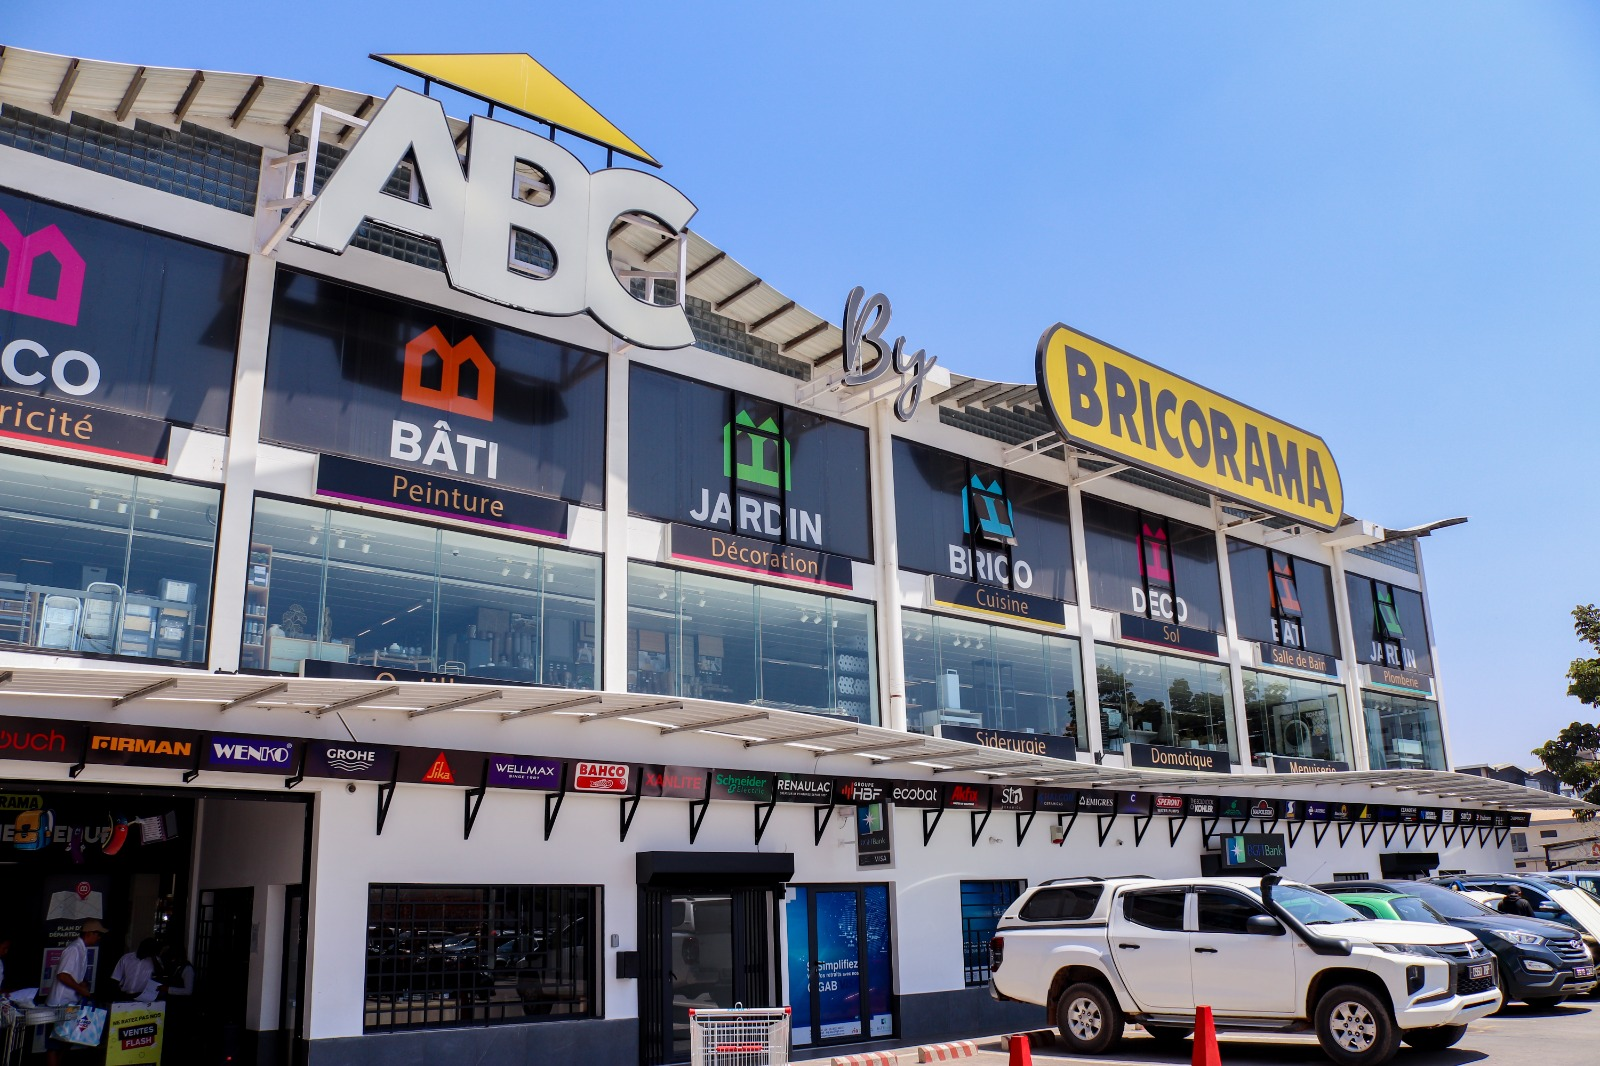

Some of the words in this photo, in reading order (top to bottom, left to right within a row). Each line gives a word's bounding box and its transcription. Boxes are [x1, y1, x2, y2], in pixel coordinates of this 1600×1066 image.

[287, 84, 699, 344] ABC
[841, 285, 938, 421] By
[1064, 344, 1334, 514] BRICORAMA
[389, 419, 499, 480] BÂTI
[392, 475, 505, 517] Peinture
[690, 487, 823, 546] JARDIN
[711, 537, 819, 575] Décoration
[948, 543, 1033, 589] BRICO
[976, 588, 1029, 615] Cuisine
[1162, 625, 1180, 644] Sol
[1273, 649, 1294, 666] Salle
[1296, 653, 1307, 667] de
[1308, 656, 1327, 672] Bain
[1383, 671, 1419, 688] Plomberie
[91, 736, 192, 756] FIRMAN
[213, 743, 289, 763] WENKO
[326, 748, 375, 762] GROHE
[1151, 747, 1213, 770] Domotique
[426, 761, 450, 780] Sika
[495, 763, 555, 776] WELLMAX
[580, 763, 626, 778] BAHCO
[645, 773, 702, 790] XANLITE
[715, 773, 767, 788] Schneider
[736, 785, 765, 795] Electric
[777, 779, 831, 793] RENAULAC
[852, 787, 883, 801] HBF
[893, 787, 938, 802] ecobat
[874, 855, 887, 863] VISA
[818, 980, 838, 992] GAB
[122, 1025, 155, 1037] VENTES
[125, 1036, 152, 1048] FLASH
